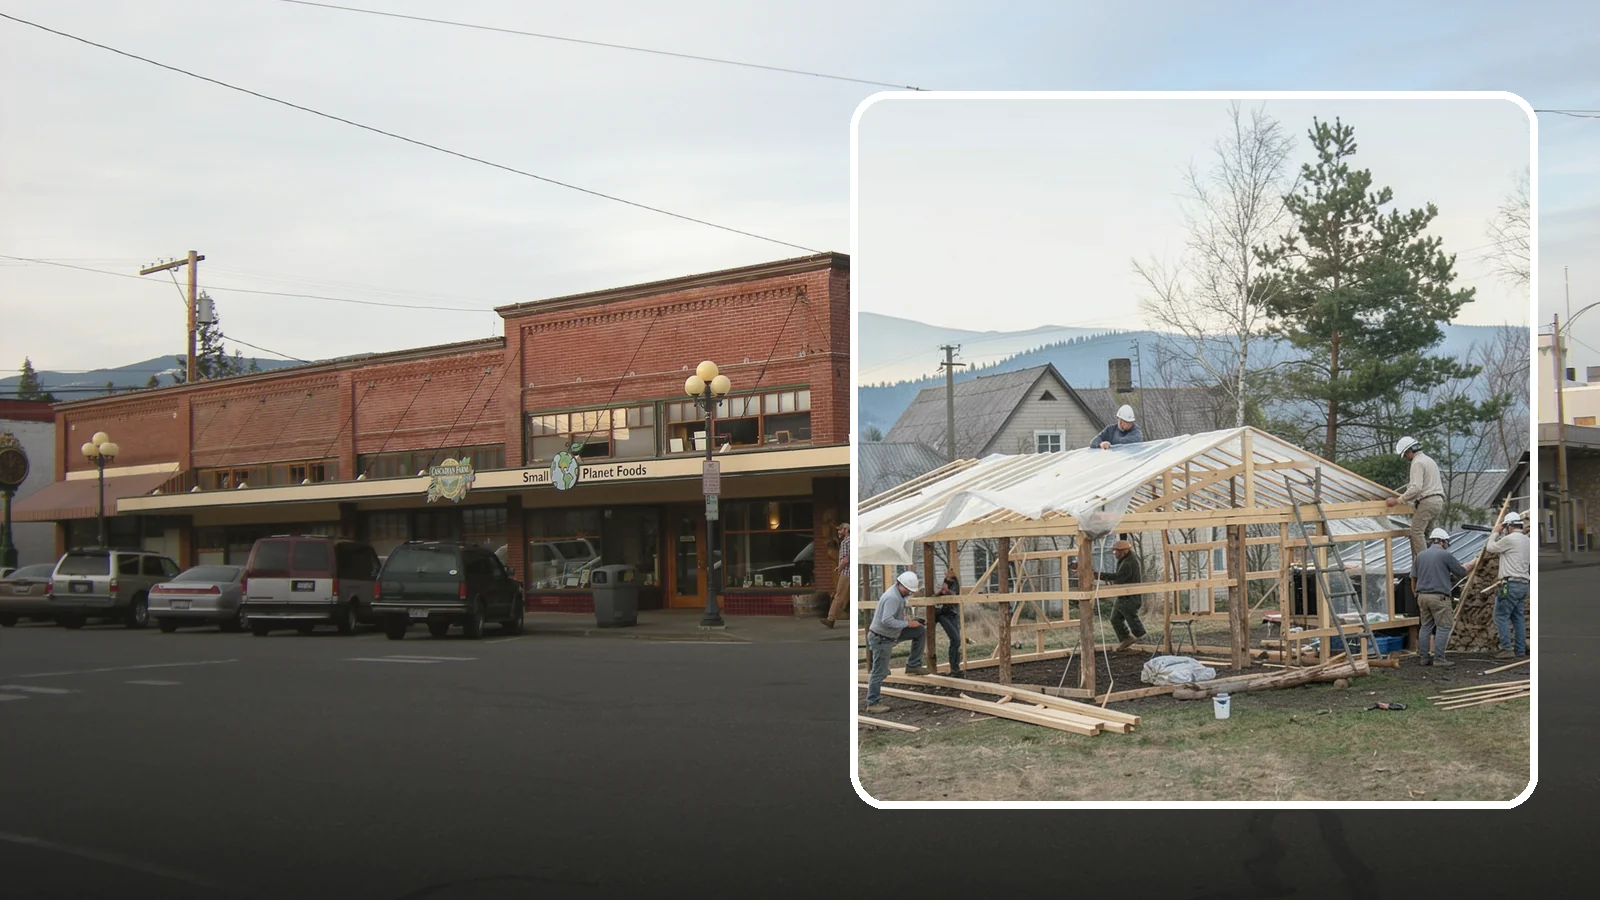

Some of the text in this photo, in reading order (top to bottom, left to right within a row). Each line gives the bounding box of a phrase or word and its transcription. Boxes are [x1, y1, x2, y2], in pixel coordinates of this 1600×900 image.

[523, 464, 647, 483] Small Planet Foods
